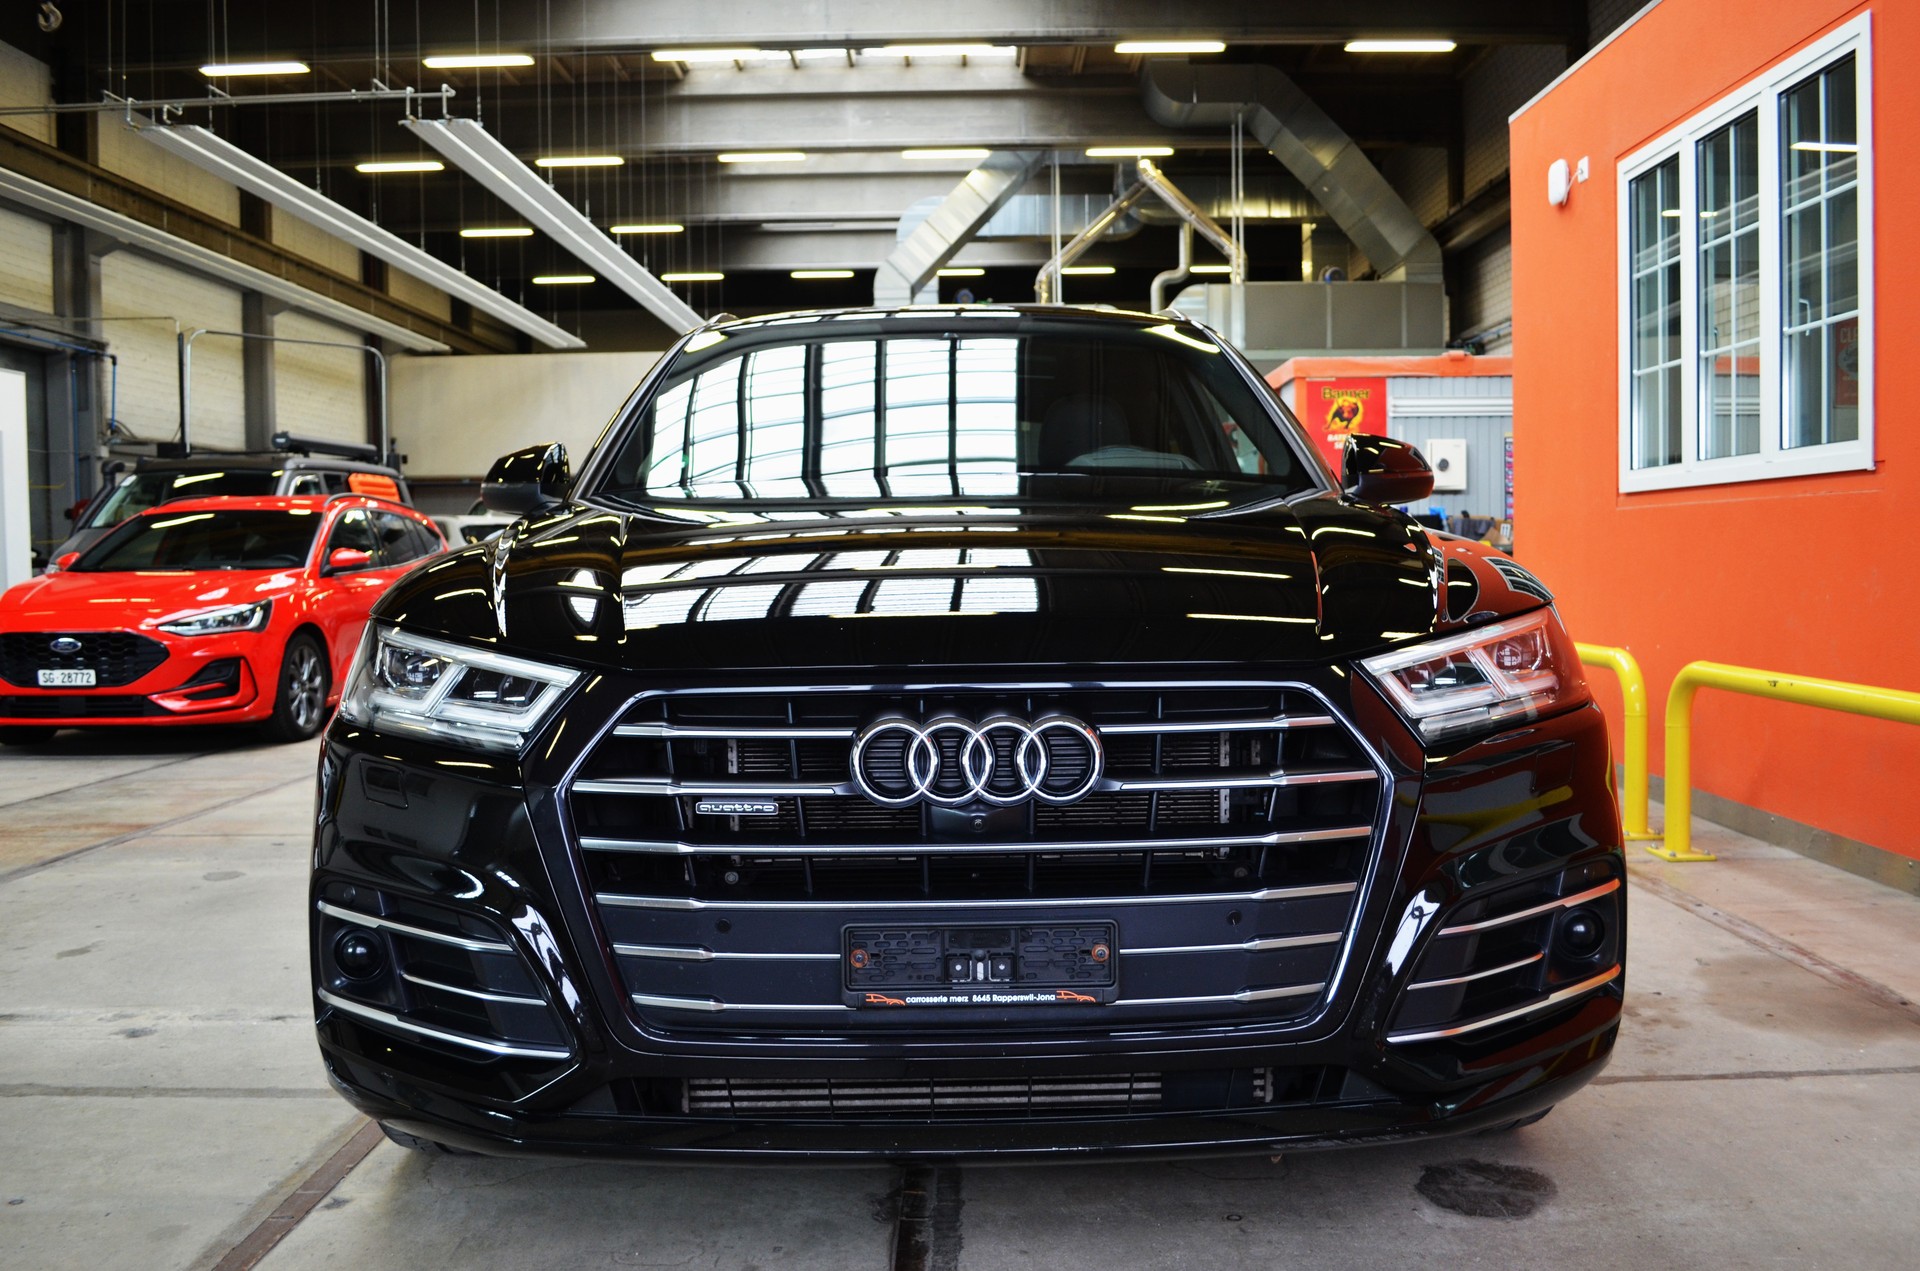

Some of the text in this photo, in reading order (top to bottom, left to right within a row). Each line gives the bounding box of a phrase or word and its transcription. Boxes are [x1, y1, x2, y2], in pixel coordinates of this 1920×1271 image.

[1323, 387, 1369, 399] Banner
[60, 672, 92, 684] 28772
[699, 803, 775, 813] quattro
[905, 993, 1056, 1004] carrosserie merz 8645 Rapperswil-Jona
